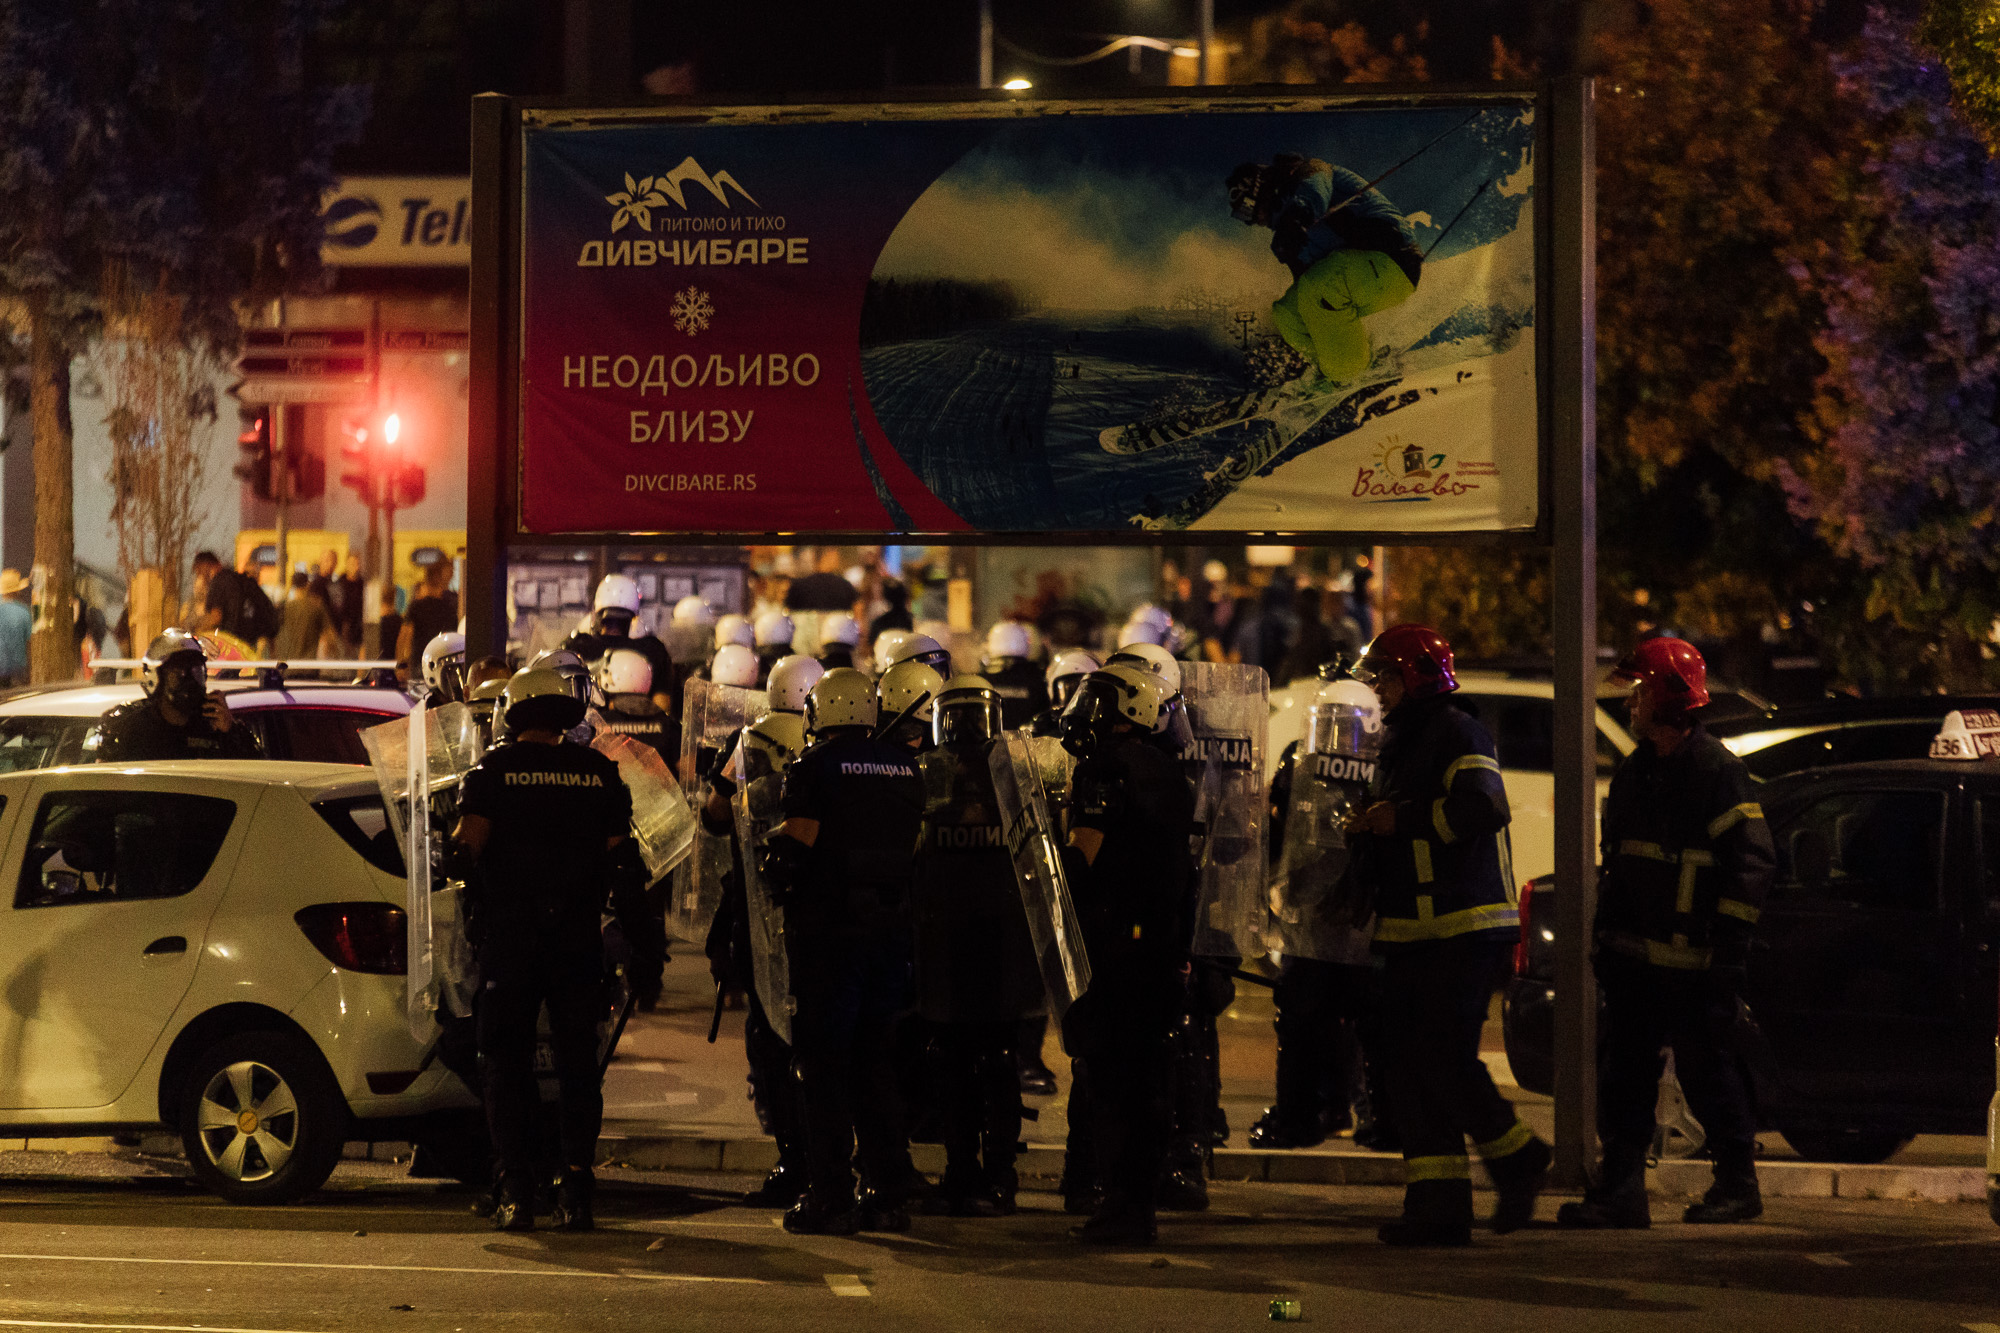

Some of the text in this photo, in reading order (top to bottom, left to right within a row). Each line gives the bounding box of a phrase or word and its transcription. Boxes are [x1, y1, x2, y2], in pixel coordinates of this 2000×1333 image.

[400, 198, 470, 246] Tel
[660, 216, 786, 232] ПИТОМО И ТИХО
[577, 238, 809, 267] ДИВЧИБАРЕ
[563, 352, 820, 396] НЕОДОЉИВО
[630, 410, 754, 443] БЛИЗУ
[625, 473, 757, 491] DIVCIBARE.RS
[504, 771, 603, 788] ПОЛИЦИЈА
[841, 762, 915, 778] ПОЛИЦИЈА
[1316, 755, 1376, 784] ПОЛИ
[937, 825, 1003, 848] ПОЛИ
